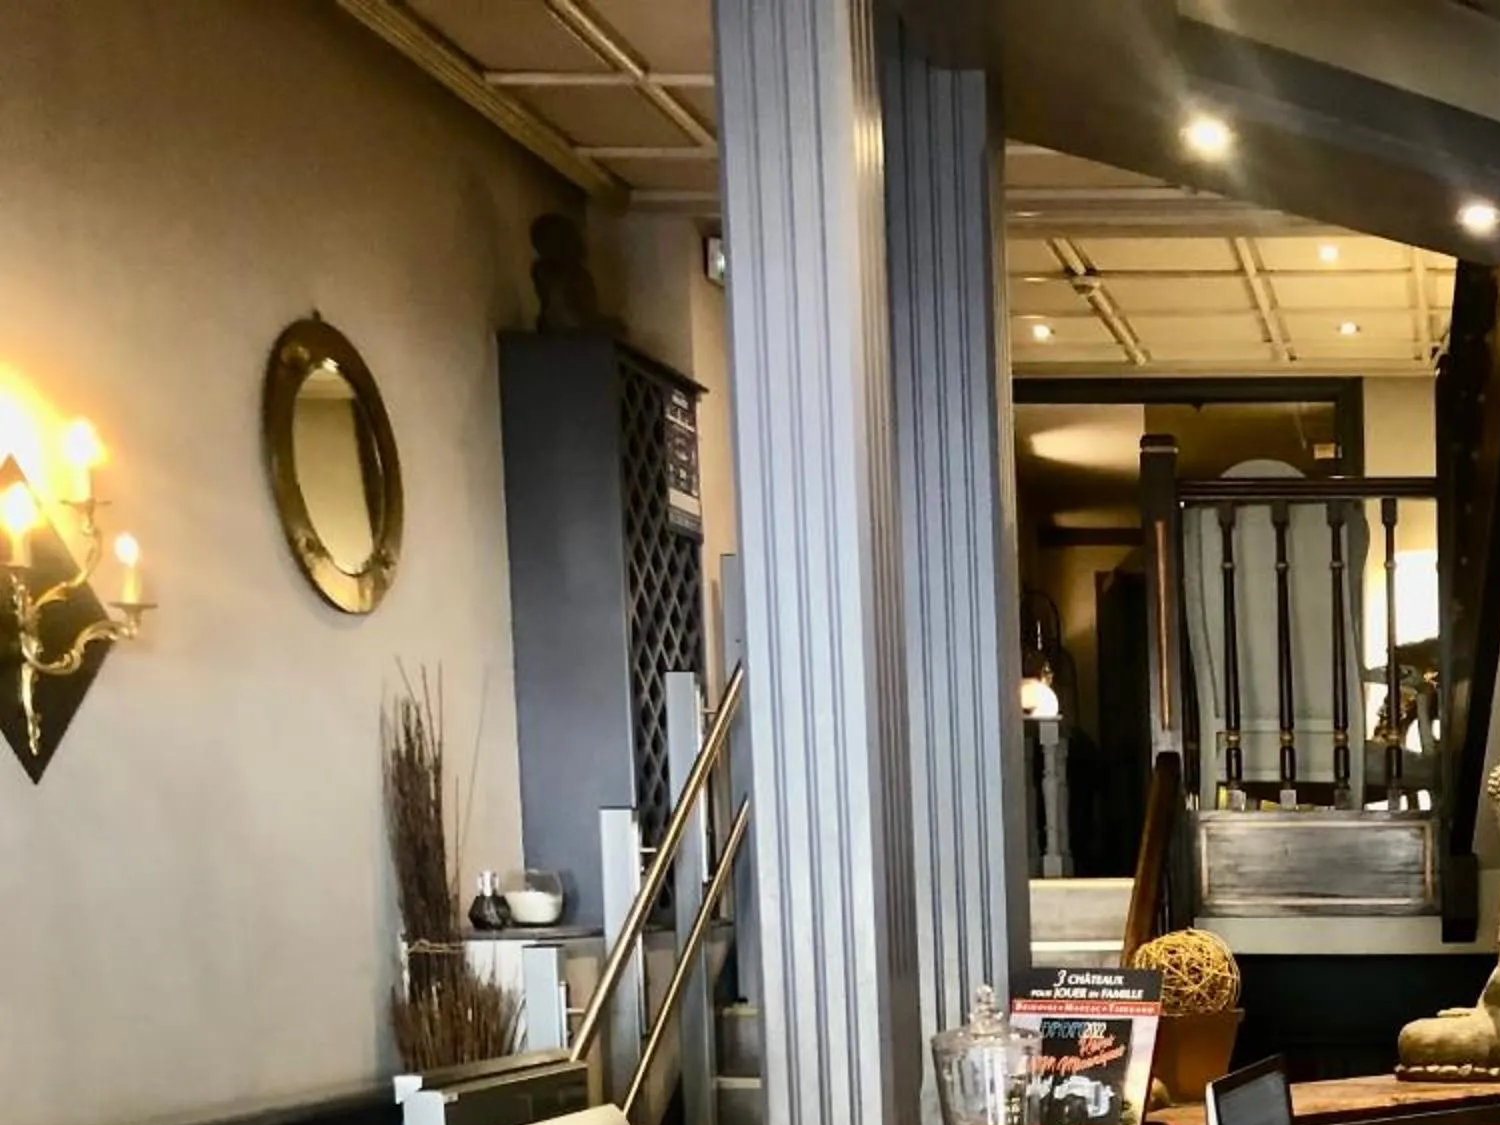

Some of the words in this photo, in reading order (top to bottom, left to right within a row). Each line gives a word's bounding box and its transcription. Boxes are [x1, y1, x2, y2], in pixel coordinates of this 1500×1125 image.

[1053, 969, 1067, 987] 3
[1067, 971, 1125, 985] CHÂTEAUX
[1053, 987, 1088, 999] JOUER
[1100, 989, 1144, 999] FAMILLE
